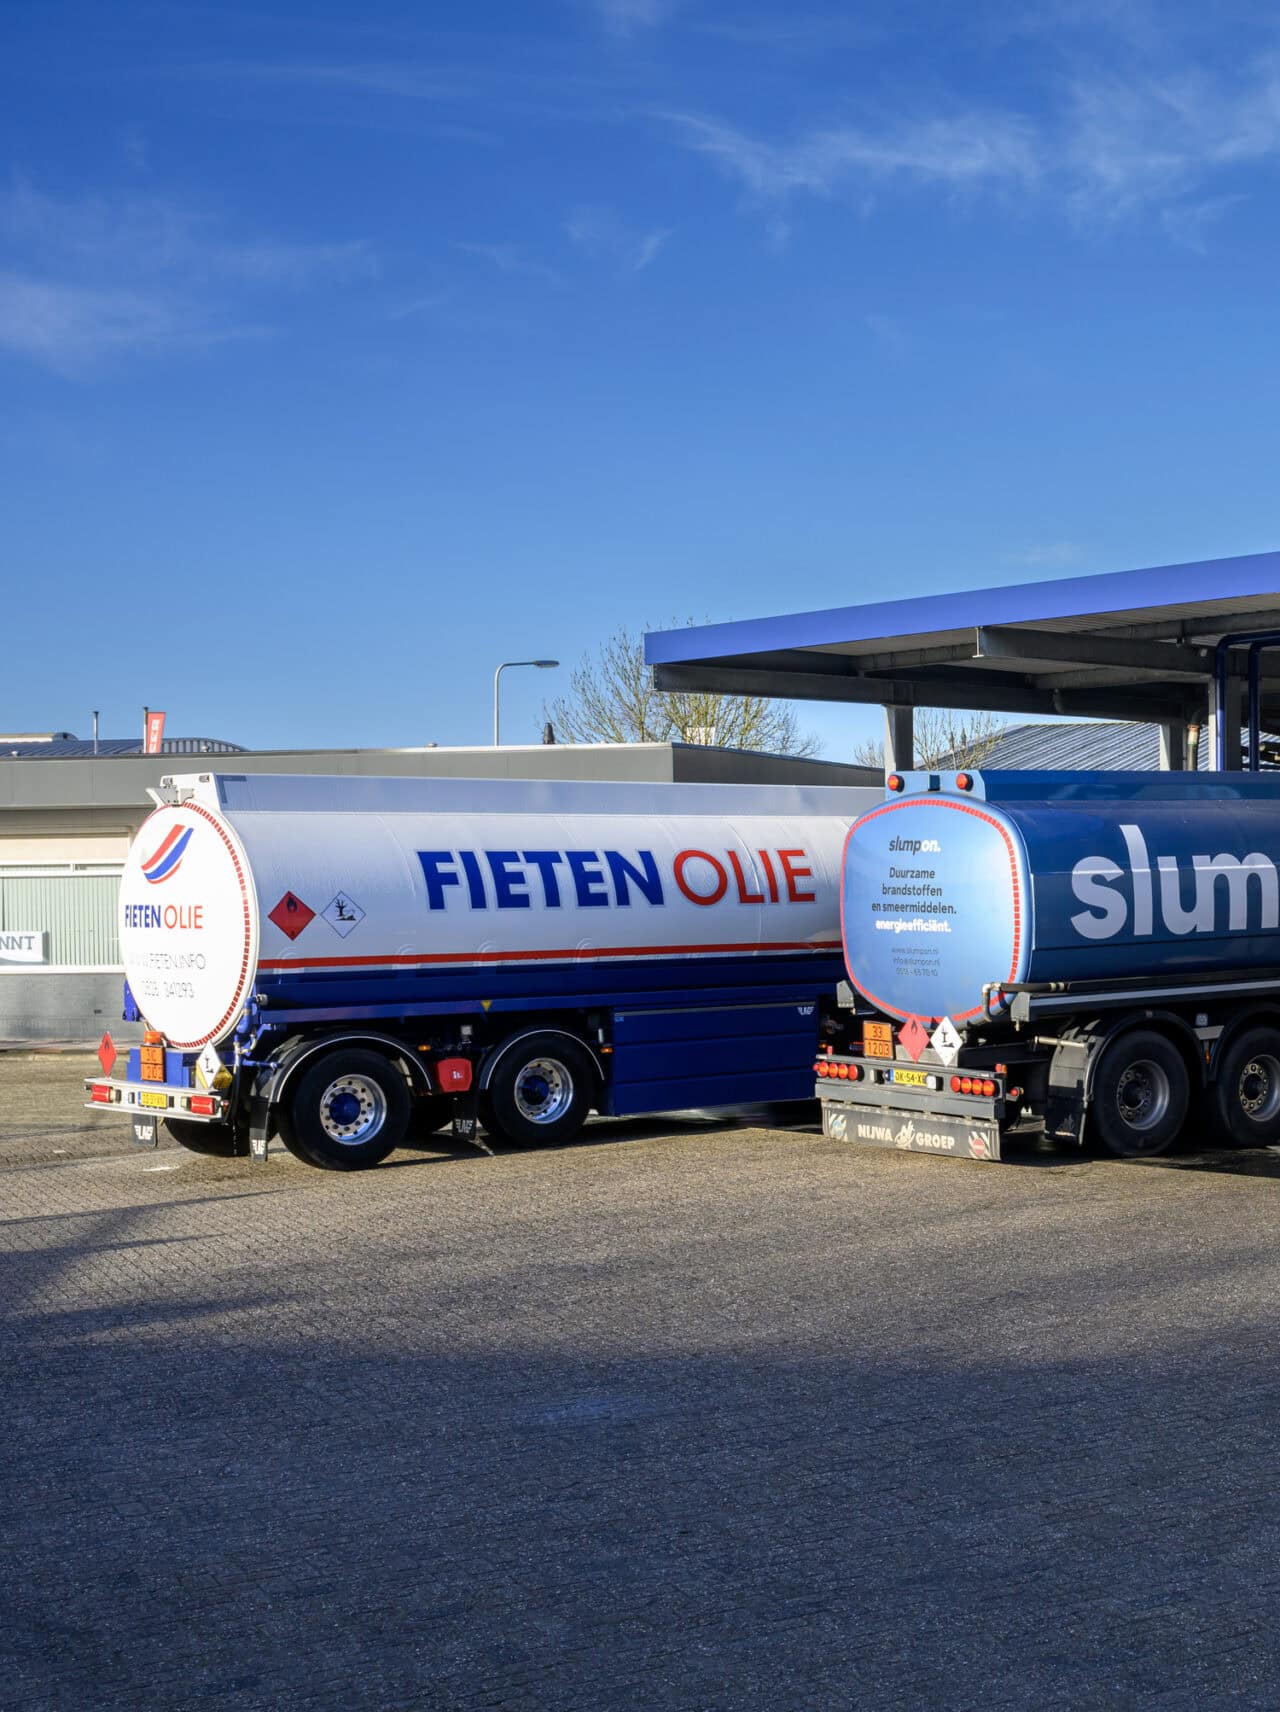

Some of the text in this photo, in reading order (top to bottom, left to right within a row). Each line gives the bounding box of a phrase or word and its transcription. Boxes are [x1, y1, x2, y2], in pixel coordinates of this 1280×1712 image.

[417, 850, 816, 910] FIETEN OLIE
[889, 867, 935, 879] Duurzame
[882, 884, 942, 896] brandstoffen
[872, 902, 957, 914] en smeermiddelen.
[125, 905, 203, 929] FIETEN OLIE
[872, 1025, 883, 1039] 33
[868, 1042, 891, 1056] 1203
[916, 1132, 955, 1149] GROEP
